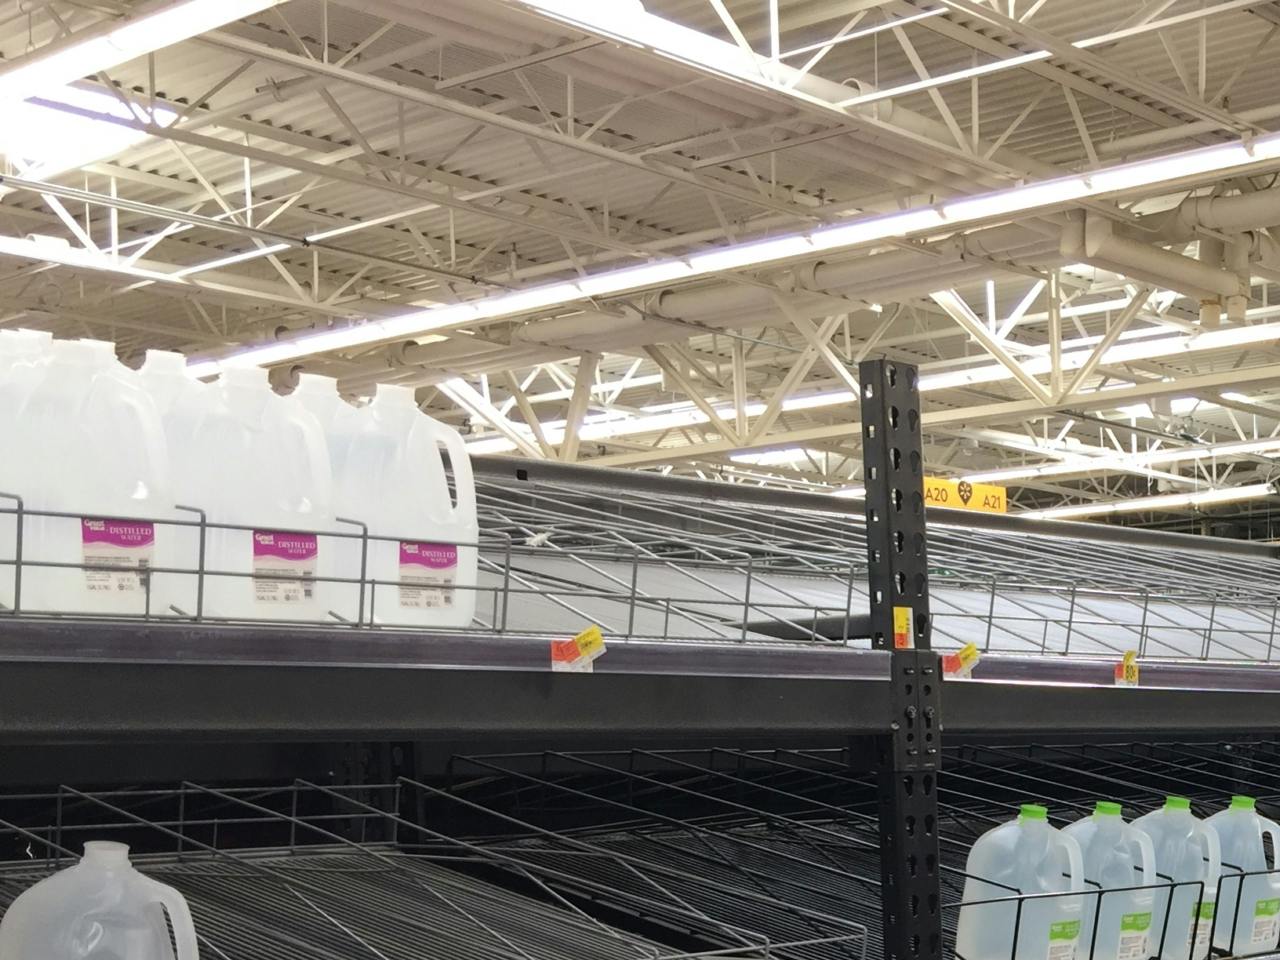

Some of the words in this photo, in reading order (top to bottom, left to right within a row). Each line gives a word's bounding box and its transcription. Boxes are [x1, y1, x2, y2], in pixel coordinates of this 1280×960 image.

[925, 487, 949, 503] A20
[983, 495, 1001, 509] A21
[109, 526, 152, 536] DISTILLED
[277, 540, 316, 550] DISTILLED
[421, 550, 456, 559] DISTILLED
